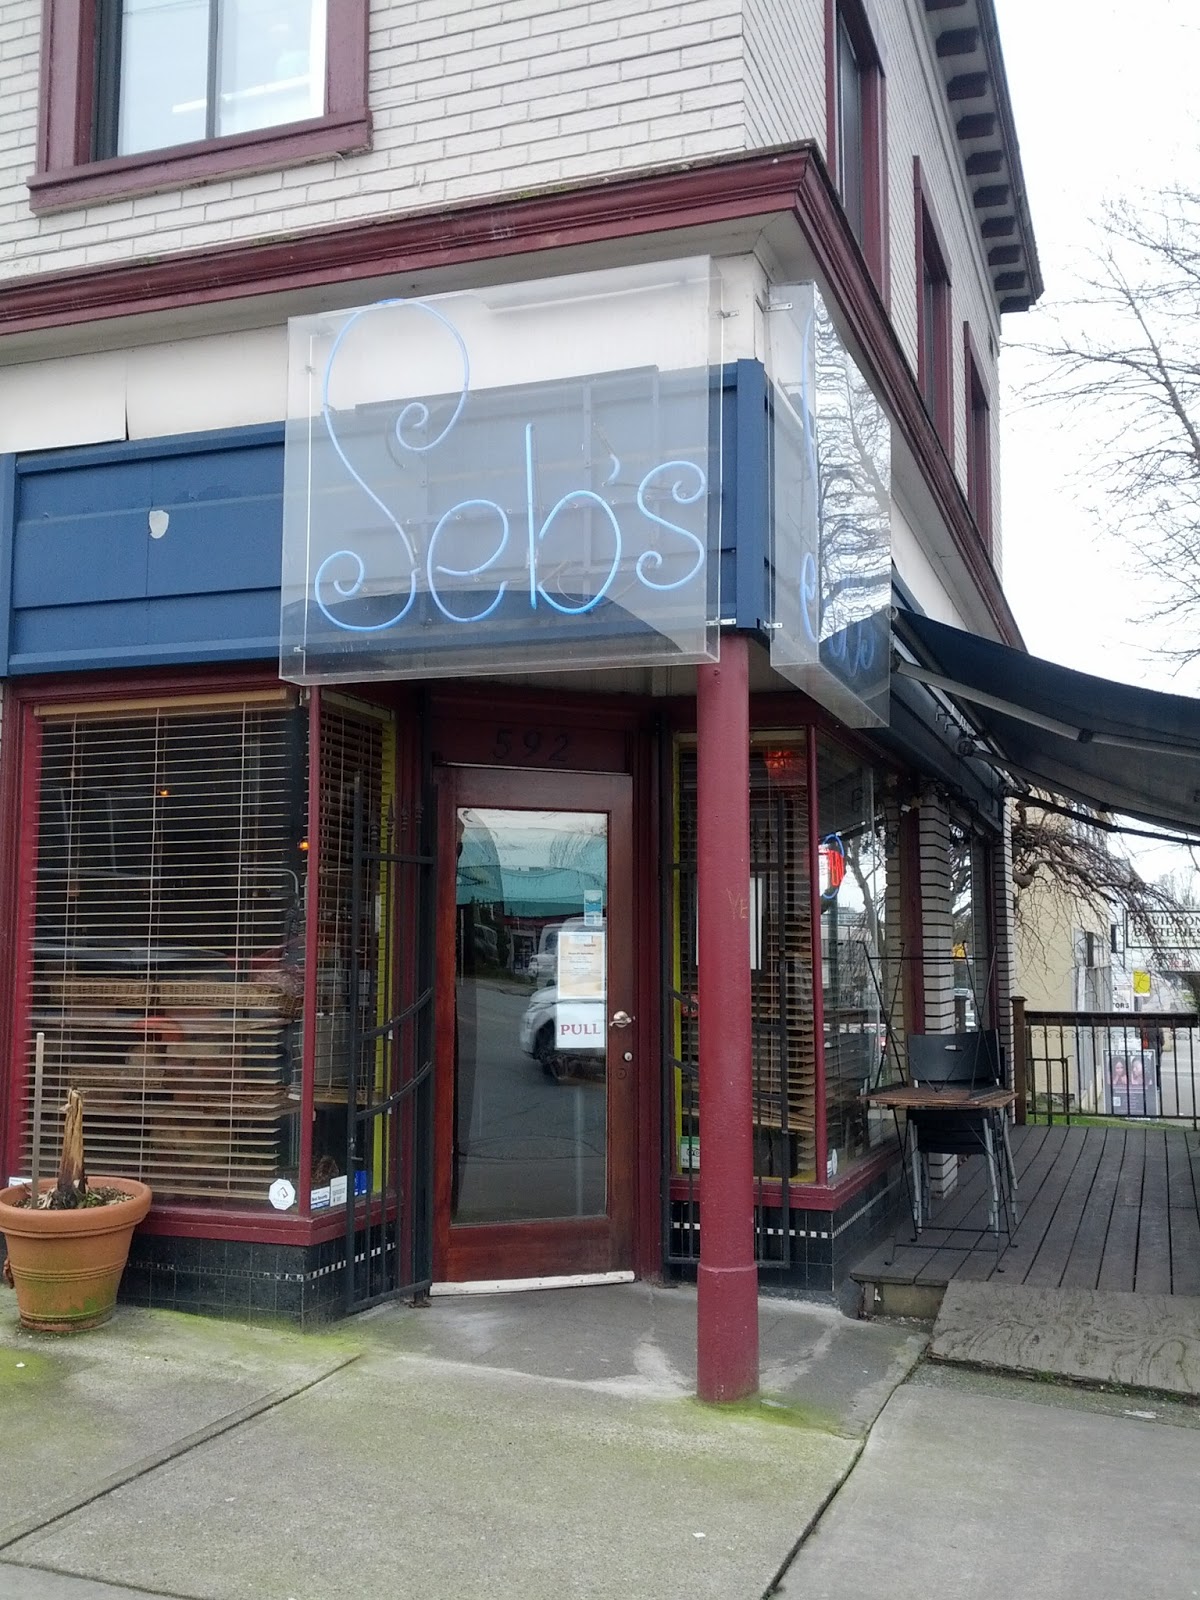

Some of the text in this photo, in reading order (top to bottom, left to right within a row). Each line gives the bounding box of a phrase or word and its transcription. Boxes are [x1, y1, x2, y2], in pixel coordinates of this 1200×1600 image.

[314, 297, 708, 632] Seb's
[490, 727, 571, 762] 592
[560, 1023, 600, 1036] PULL
